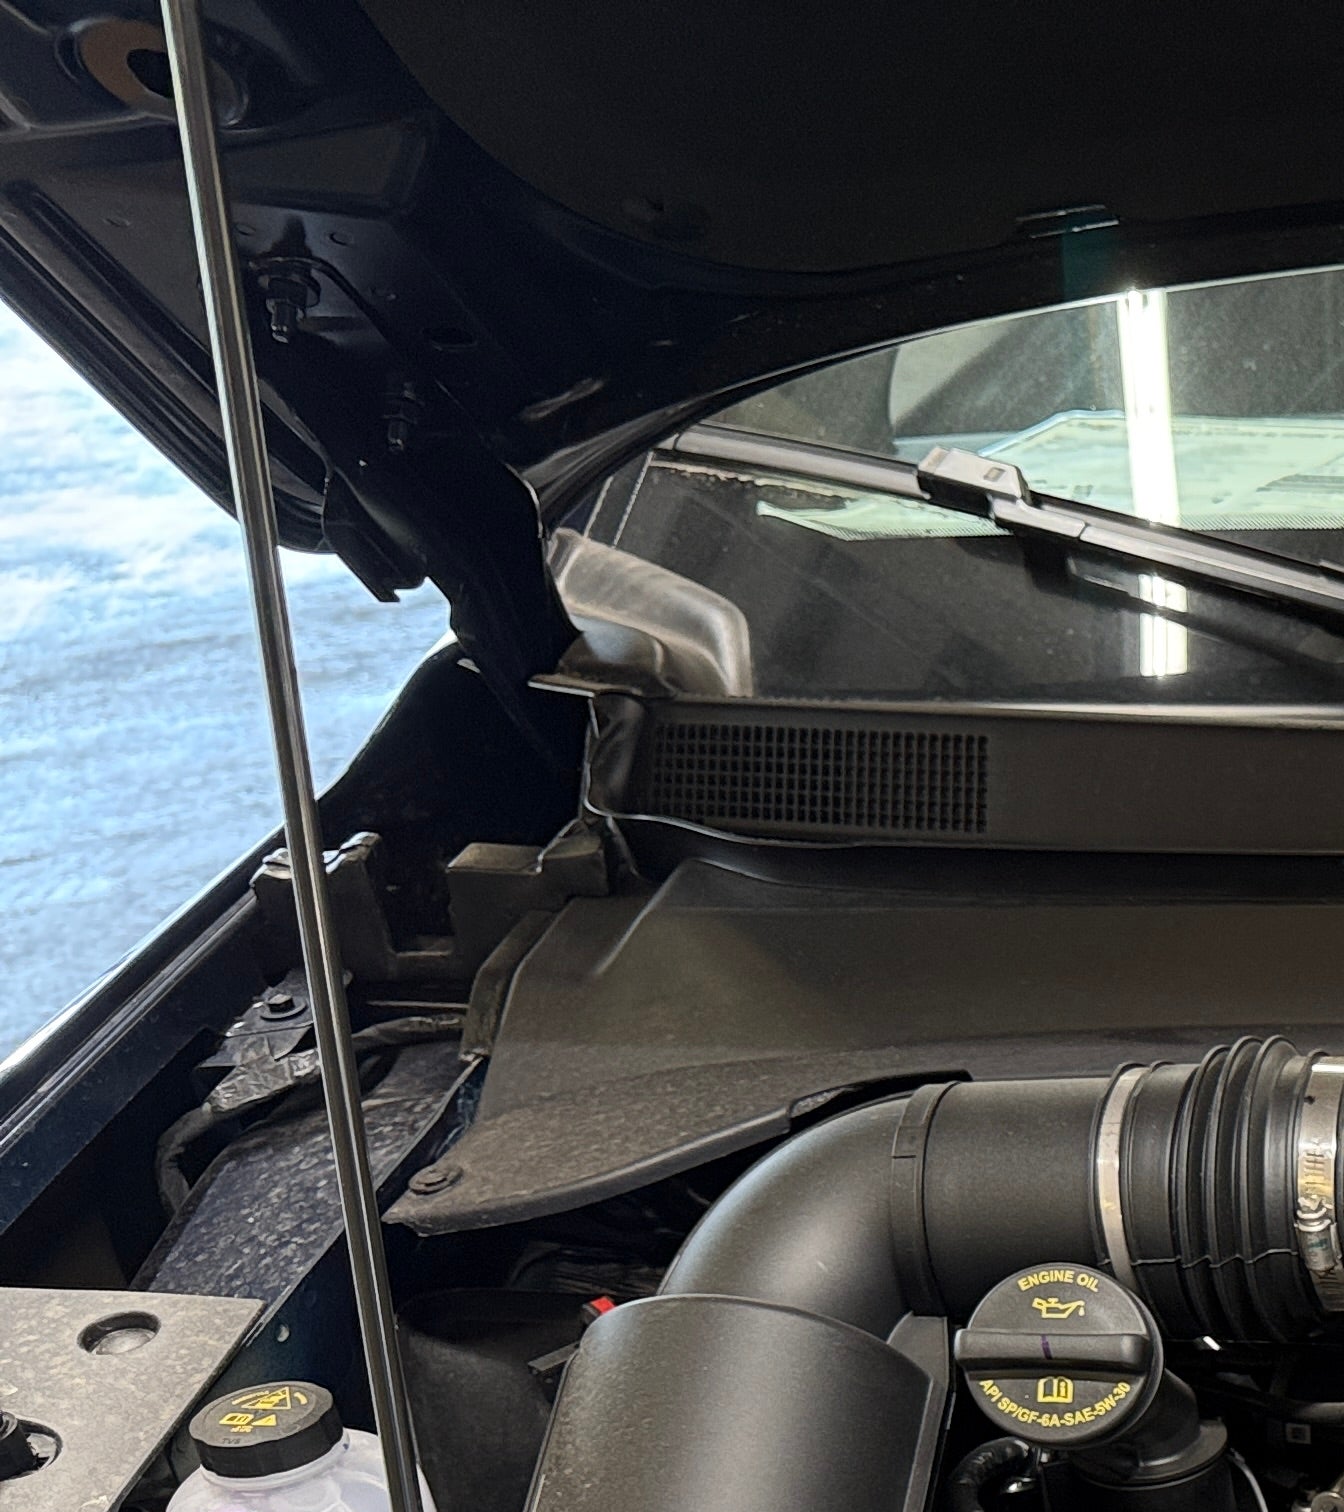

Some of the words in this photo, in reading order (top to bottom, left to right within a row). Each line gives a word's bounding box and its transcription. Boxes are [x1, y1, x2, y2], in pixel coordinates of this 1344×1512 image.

[1017, 1270, 1074, 1292] ENGINE
[1076, 1273, 1100, 1293] OIL
[980, 1379, 1000, 1403] API
